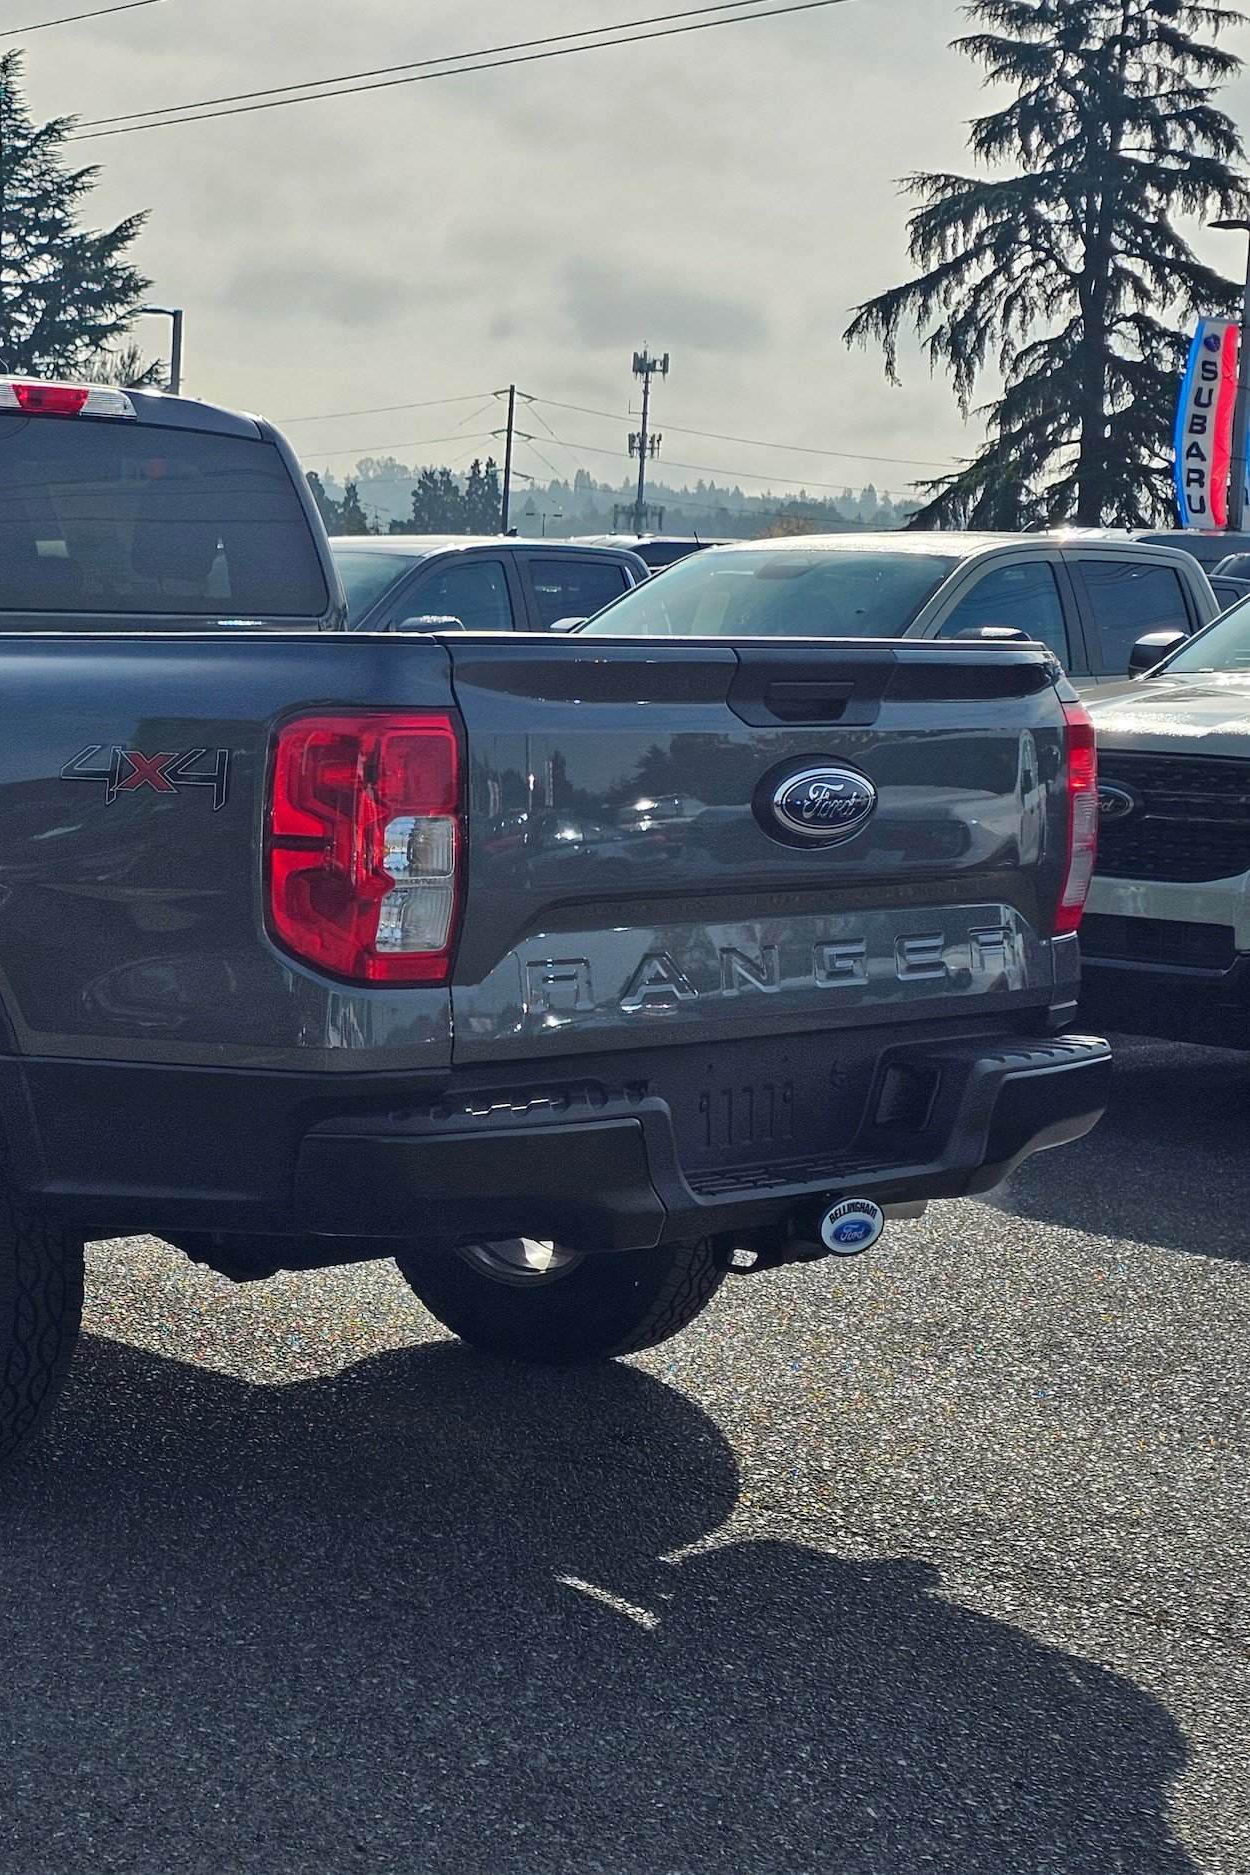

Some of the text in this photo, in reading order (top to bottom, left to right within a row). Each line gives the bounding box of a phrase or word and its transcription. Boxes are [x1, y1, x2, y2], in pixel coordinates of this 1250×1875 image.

[1185, 360, 1218, 514] SUBARU
[802, 783, 859, 819] Ford
[526, 924, 1020, 1012] RANGER
[829, 1202, 878, 1224] BELLINGHAM
[840, 1224, 866, 1241] Ford
